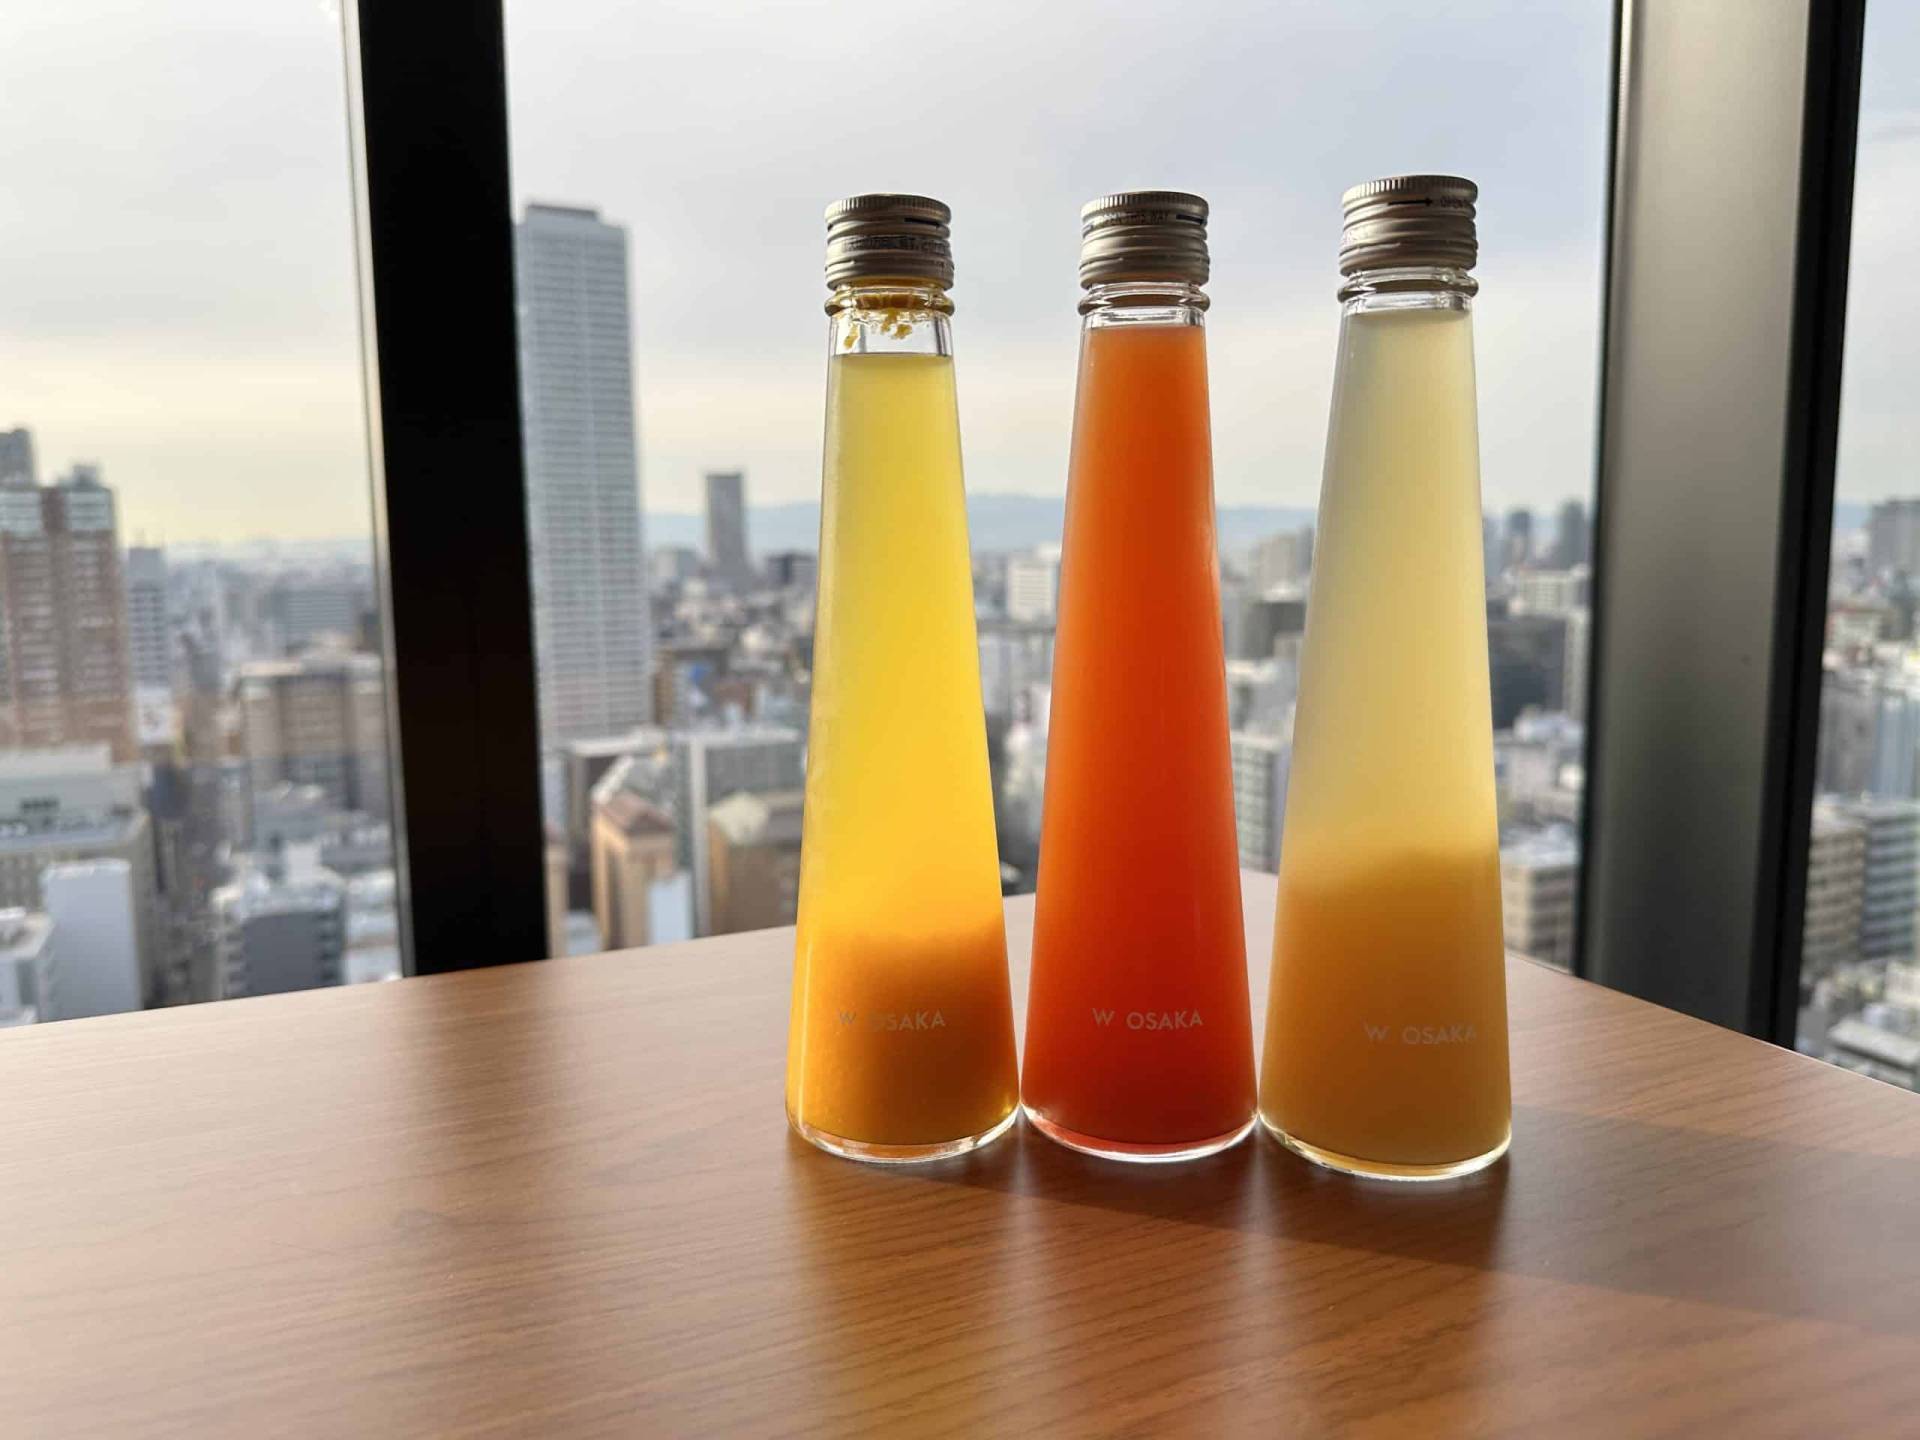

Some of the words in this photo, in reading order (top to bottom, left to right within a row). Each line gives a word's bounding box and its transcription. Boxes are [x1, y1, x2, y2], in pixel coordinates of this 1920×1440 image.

[837, 1008, 857, 1025] W
[867, 1009, 946, 1031] SAKA
[1092, 1007, 1116, 1026] W
[1125, 1009, 1204, 1031] OSAKA
[1362, 1018, 1391, 1041] W
[1402, 1023, 1478, 1045] OSAKA
